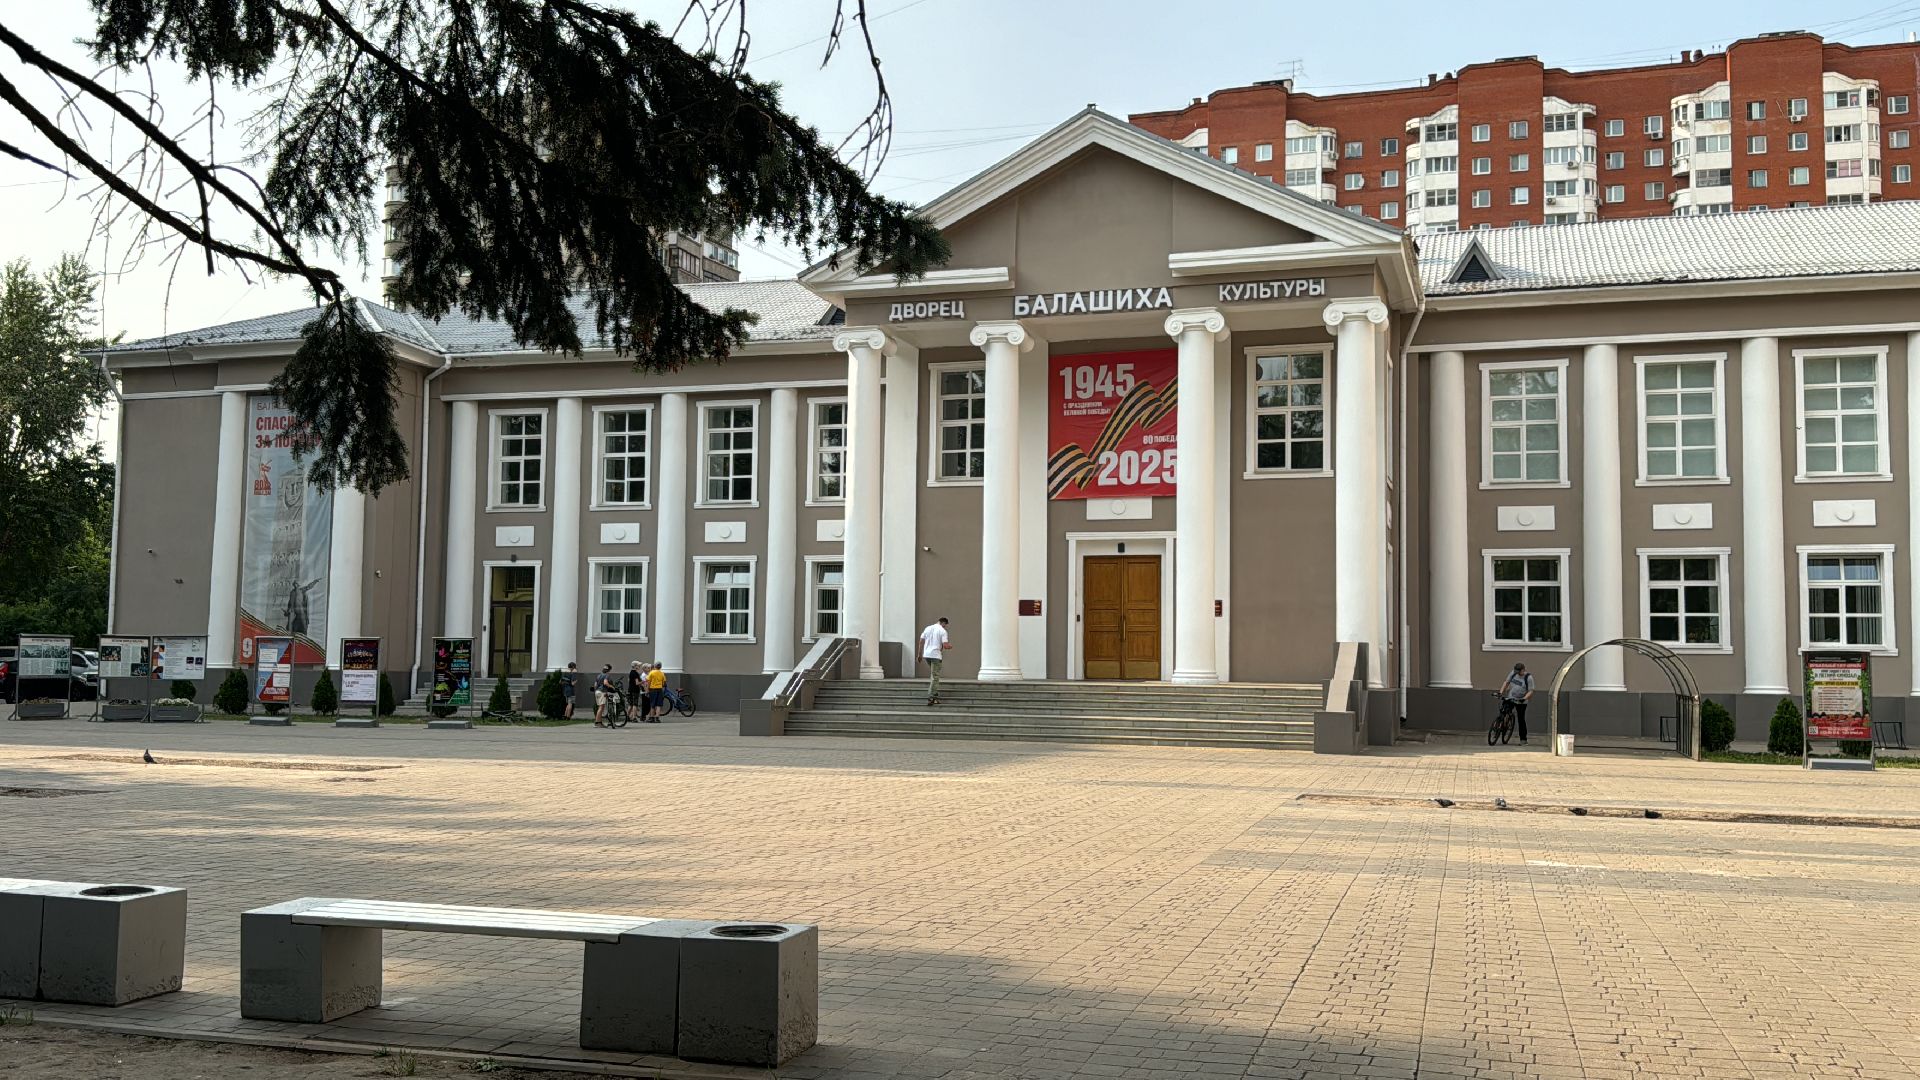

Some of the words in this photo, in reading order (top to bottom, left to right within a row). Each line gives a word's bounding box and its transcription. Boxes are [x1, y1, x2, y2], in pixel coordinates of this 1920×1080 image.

[889, 300, 965, 322] ДВОРЕЦ
[1014, 286, 1173, 317] БАЛАШИХА
[1218, 278, 1326, 302] КУЛЬТУРЫ
[1059, 363, 1135, 400] 1945
[256, 434, 271, 448] ЗА
[1143, 434, 1153, 445] 80
[1098, 449, 1177, 486] 2025
[242, 637, 253, 658] 9
